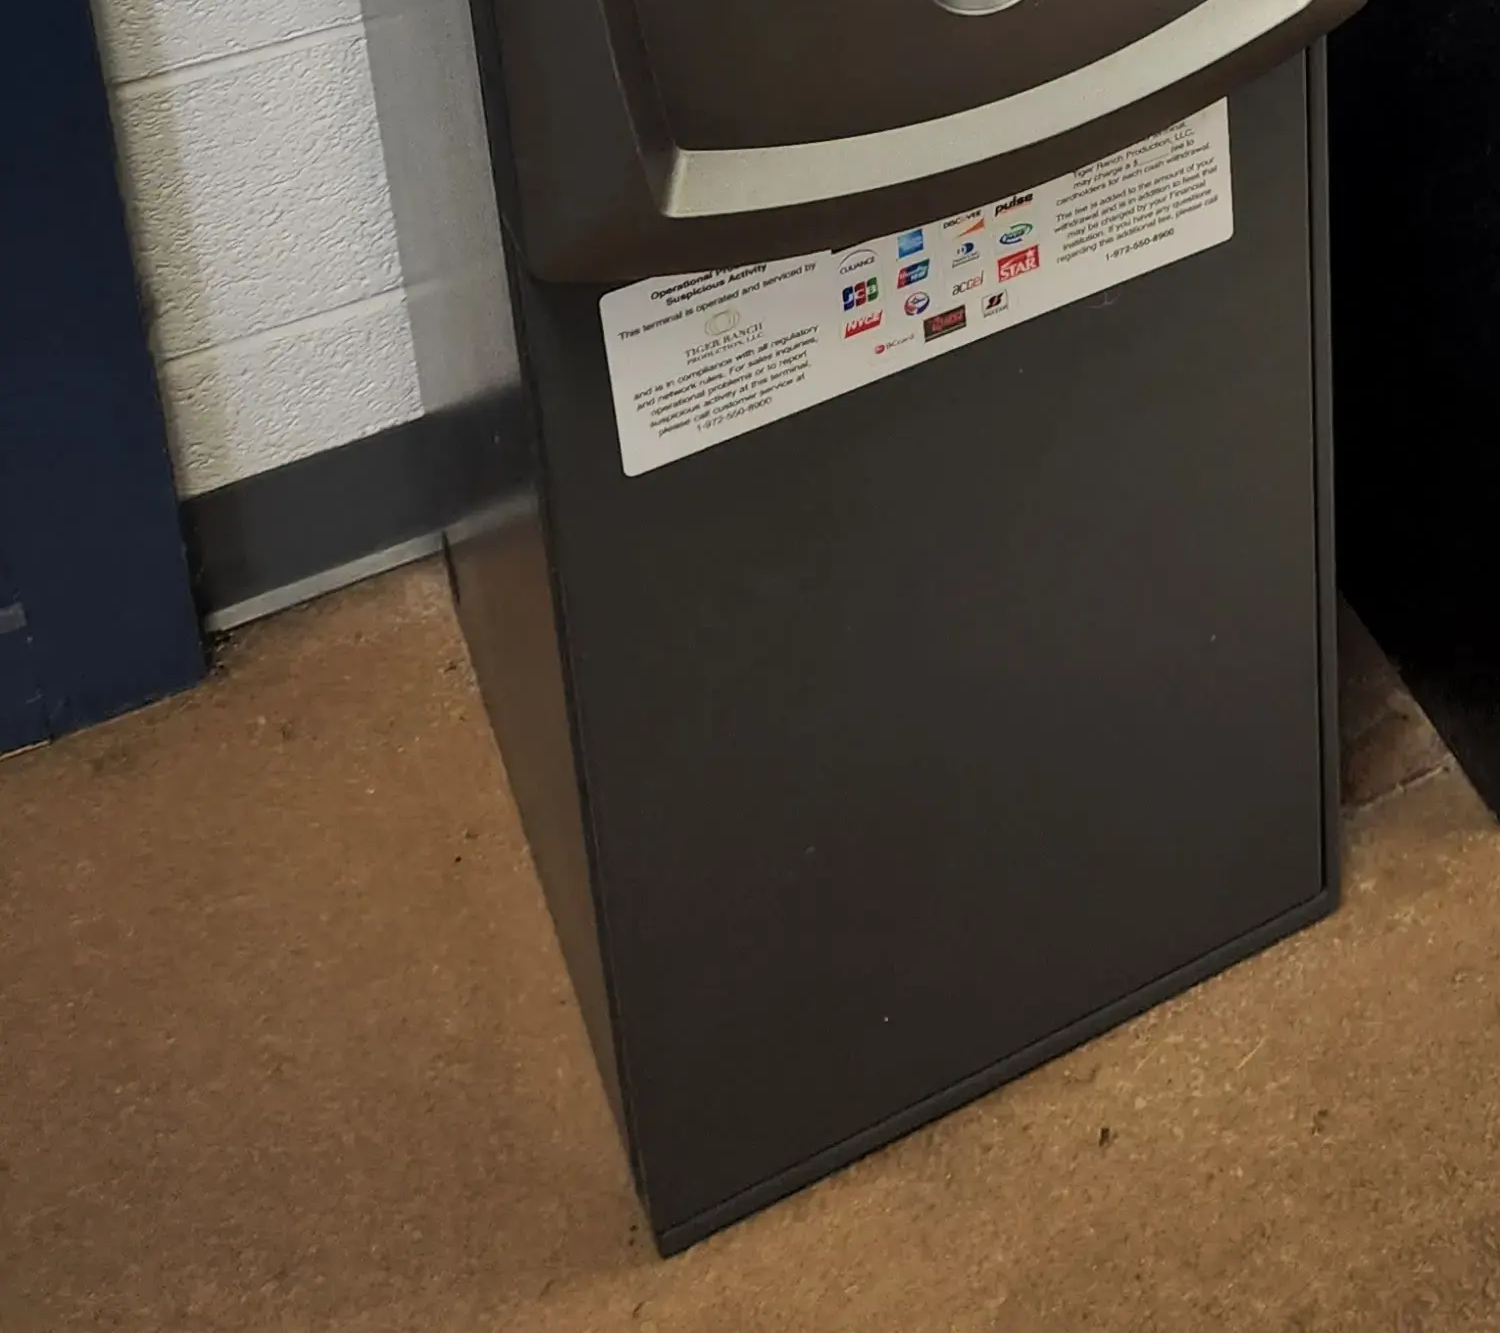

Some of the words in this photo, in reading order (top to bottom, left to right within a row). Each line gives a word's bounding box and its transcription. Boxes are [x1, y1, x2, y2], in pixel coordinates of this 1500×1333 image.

[1056, 183, 1106, 206] cardholders
[1108, 177, 1120, 186] for
[1144, 161, 1164, 172] cash
[1056, 212, 1072, 222] The
[1099, 189, 1126, 205] added
[1138, 181, 1152, 191] the
[1154, 167, 1185, 185] amount
[1186, 162, 1195, 173] of
[1196, 156, 1215, 170] your
[1073, 178, 1092, 190] may
[1094, 166, 1123, 182] charge
[1138, 184, 1171, 201] addition
[1202, 164, 1218, 177] that
[994, 193, 1034, 217] pulse
[1067, 227, 1086, 238] may
[1101, 206, 1135, 226] charged
[1149, 194, 1168, 208] your
[1169, 179, 1206, 199] Financial
[1116, 220, 1132, 231] you
[1155, 205, 1171, 215] any
[1056, 243, 1097, 263] regarding
[1116, 219, 1156, 240] additional
[650, 269, 713, 300] Operational
[666, 279, 725, 306] Suspicious
[728, 264, 767, 284] Activity
[952, 270, 984, 296] accel
[999, 255, 1037, 282] STAR
[617, 328, 641, 340] This
[642, 311, 683, 332] terminal
[685, 307, 694, 316] is
[696, 290, 739, 312] operated
[741, 282, 760, 295] and
[762, 266, 803, 287] serviced
[804, 262, 817, 273] by
[634, 387, 653, 400] and
[655, 384, 664, 392] is
[666, 379, 675, 388] in
[677, 358, 733, 384] compliance
[735, 349, 755, 361] with
[770, 324, 819, 347] regulatory
[684, 340, 720, 359] TIGER
[636, 398, 655, 412] and
[657, 383, 696, 402] network
[728, 363, 745, 375] For
[748, 353, 773, 367] sales
[650, 404, 700, 428] suspicious
[703, 390, 737, 407] activity
[739, 384, 748, 393] at
[751, 377, 768, 388] this
[651, 390, 705, 416] operational
[708, 373, 752, 396] problems
[754, 367, 765, 376] or
[767, 363, 777, 371] to
[779, 349, 807, 367] report
[712, 393, 757, 414] customer
[760, 378, 793, 395] service
[796, 372, 805, 383] at
